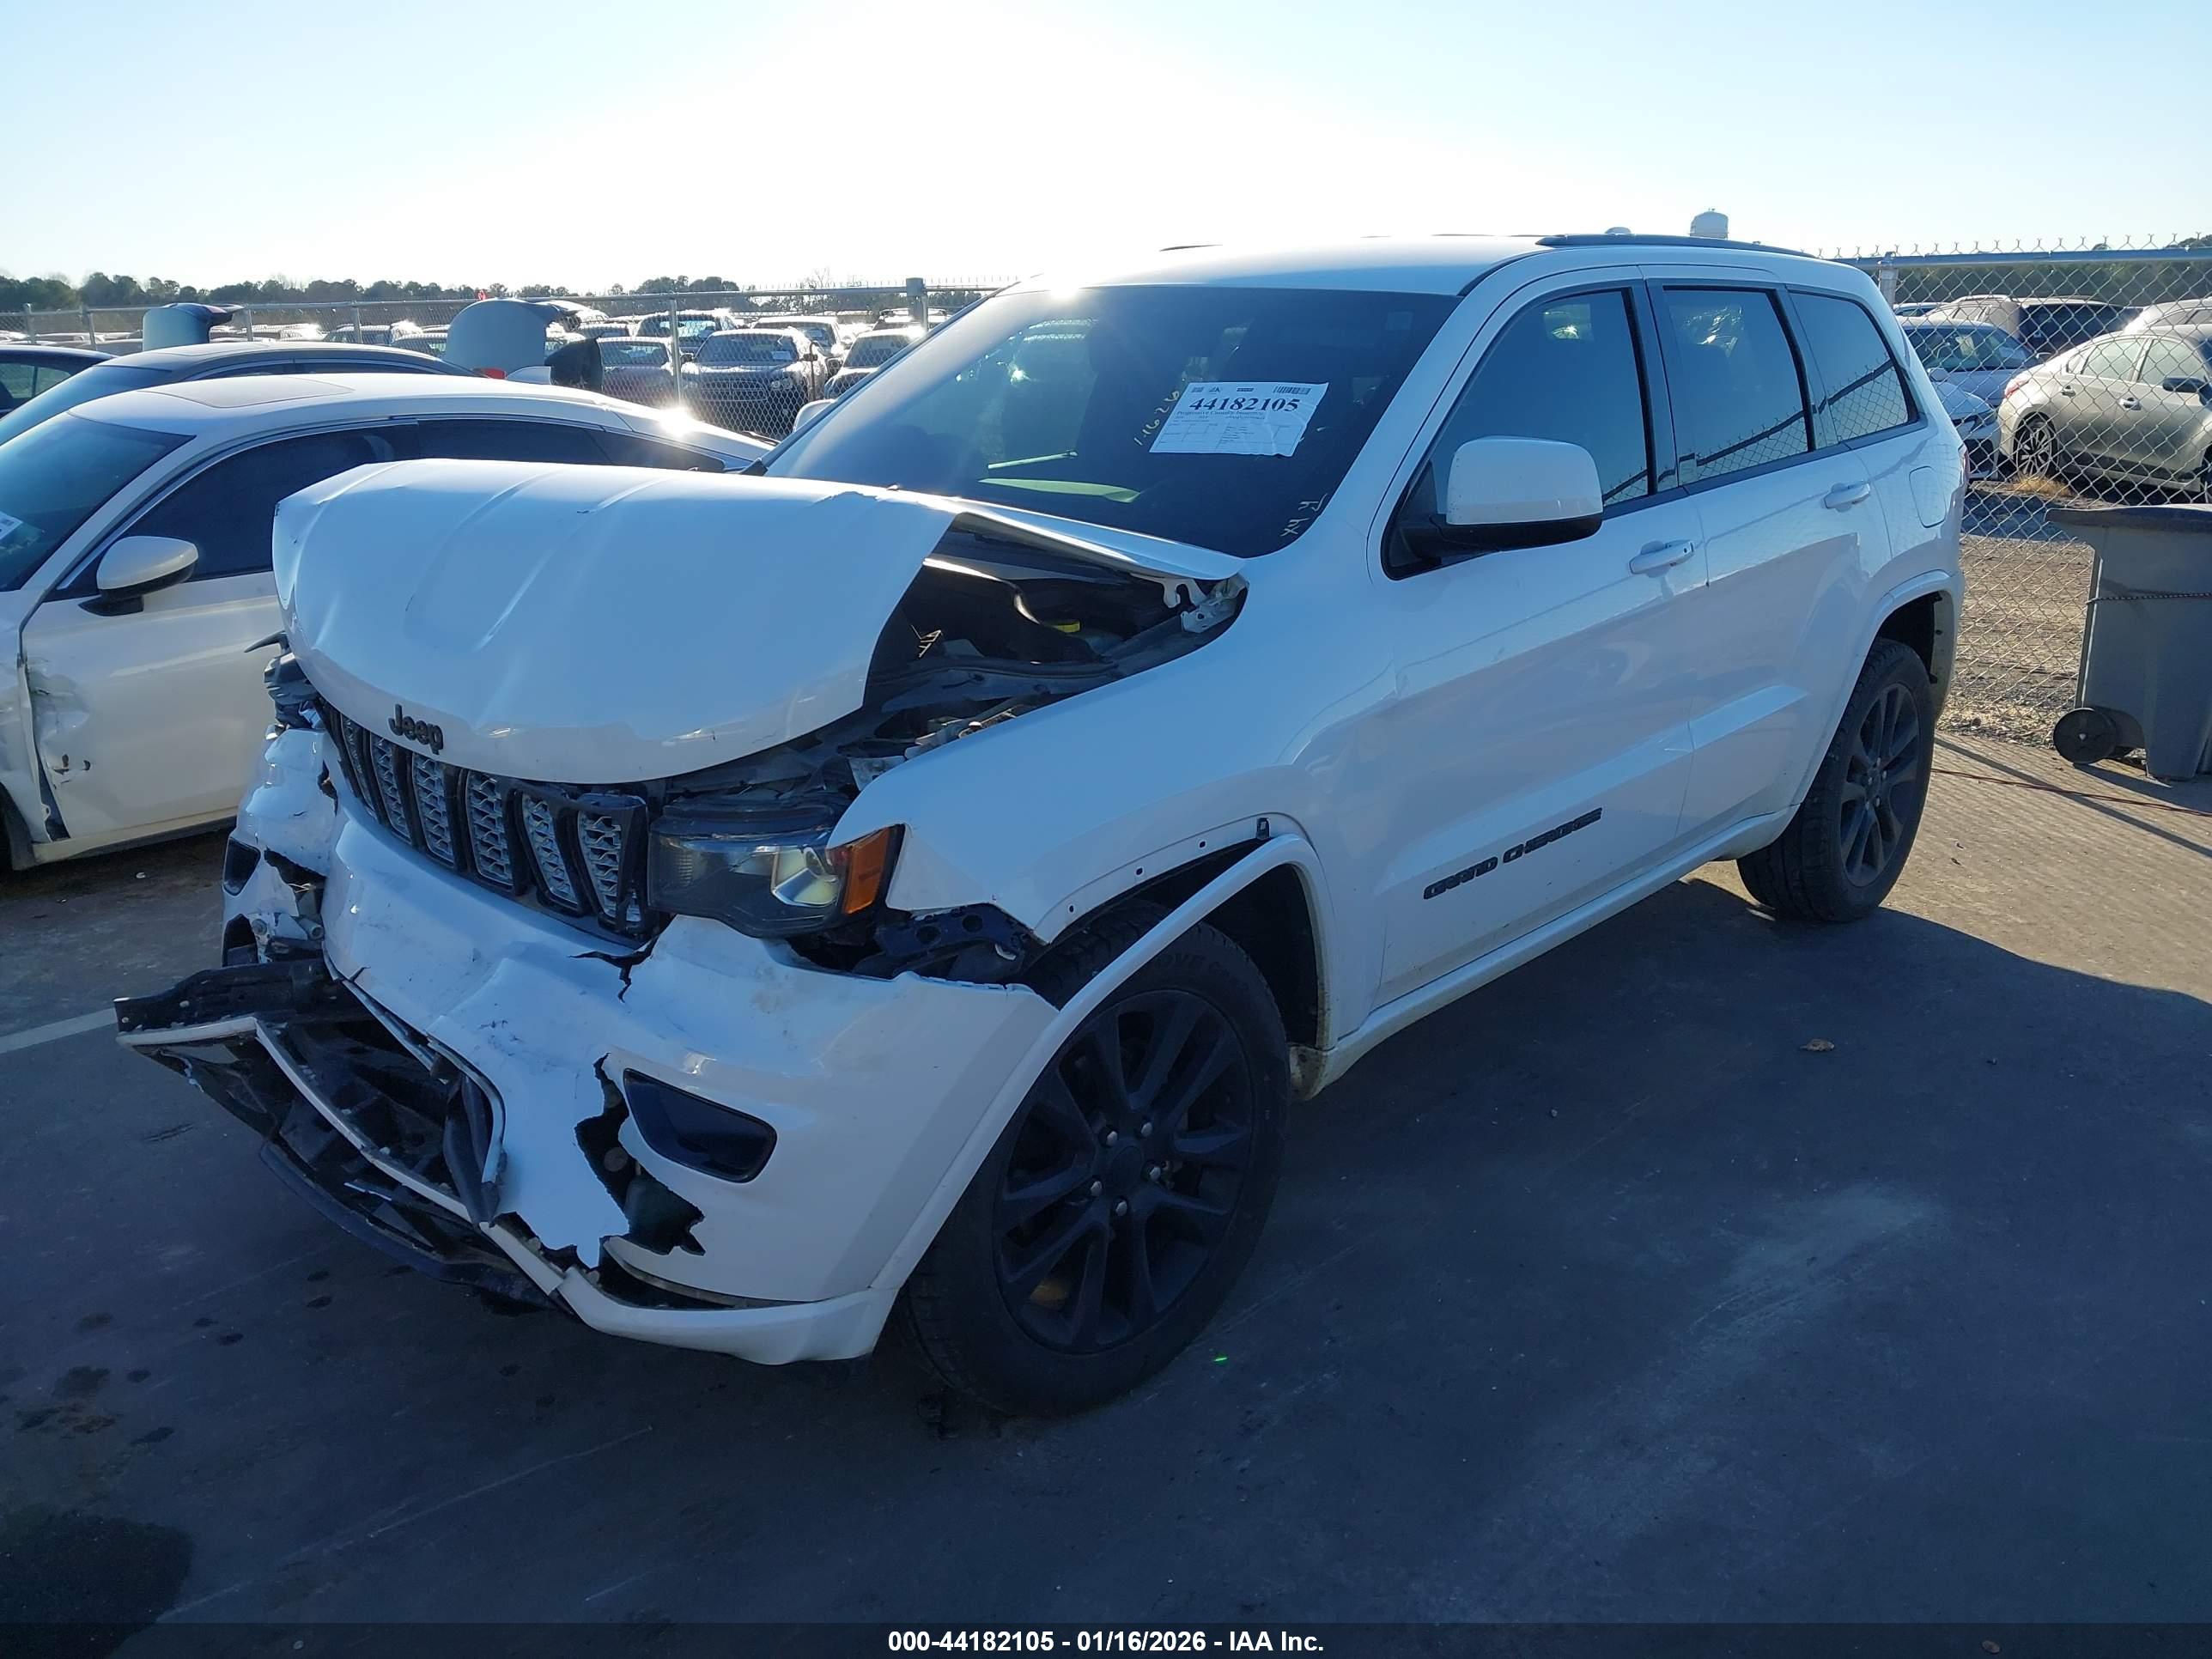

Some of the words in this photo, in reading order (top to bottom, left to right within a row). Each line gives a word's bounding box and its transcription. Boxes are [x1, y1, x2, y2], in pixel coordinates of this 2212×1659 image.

[1189, 397, 1301, 412] 44182105
[388, 703, 444, 755] Jeep
[1423, 856, 1498, 900] GRAND
[1503, 807, 1603, 864] CHEROKEE
